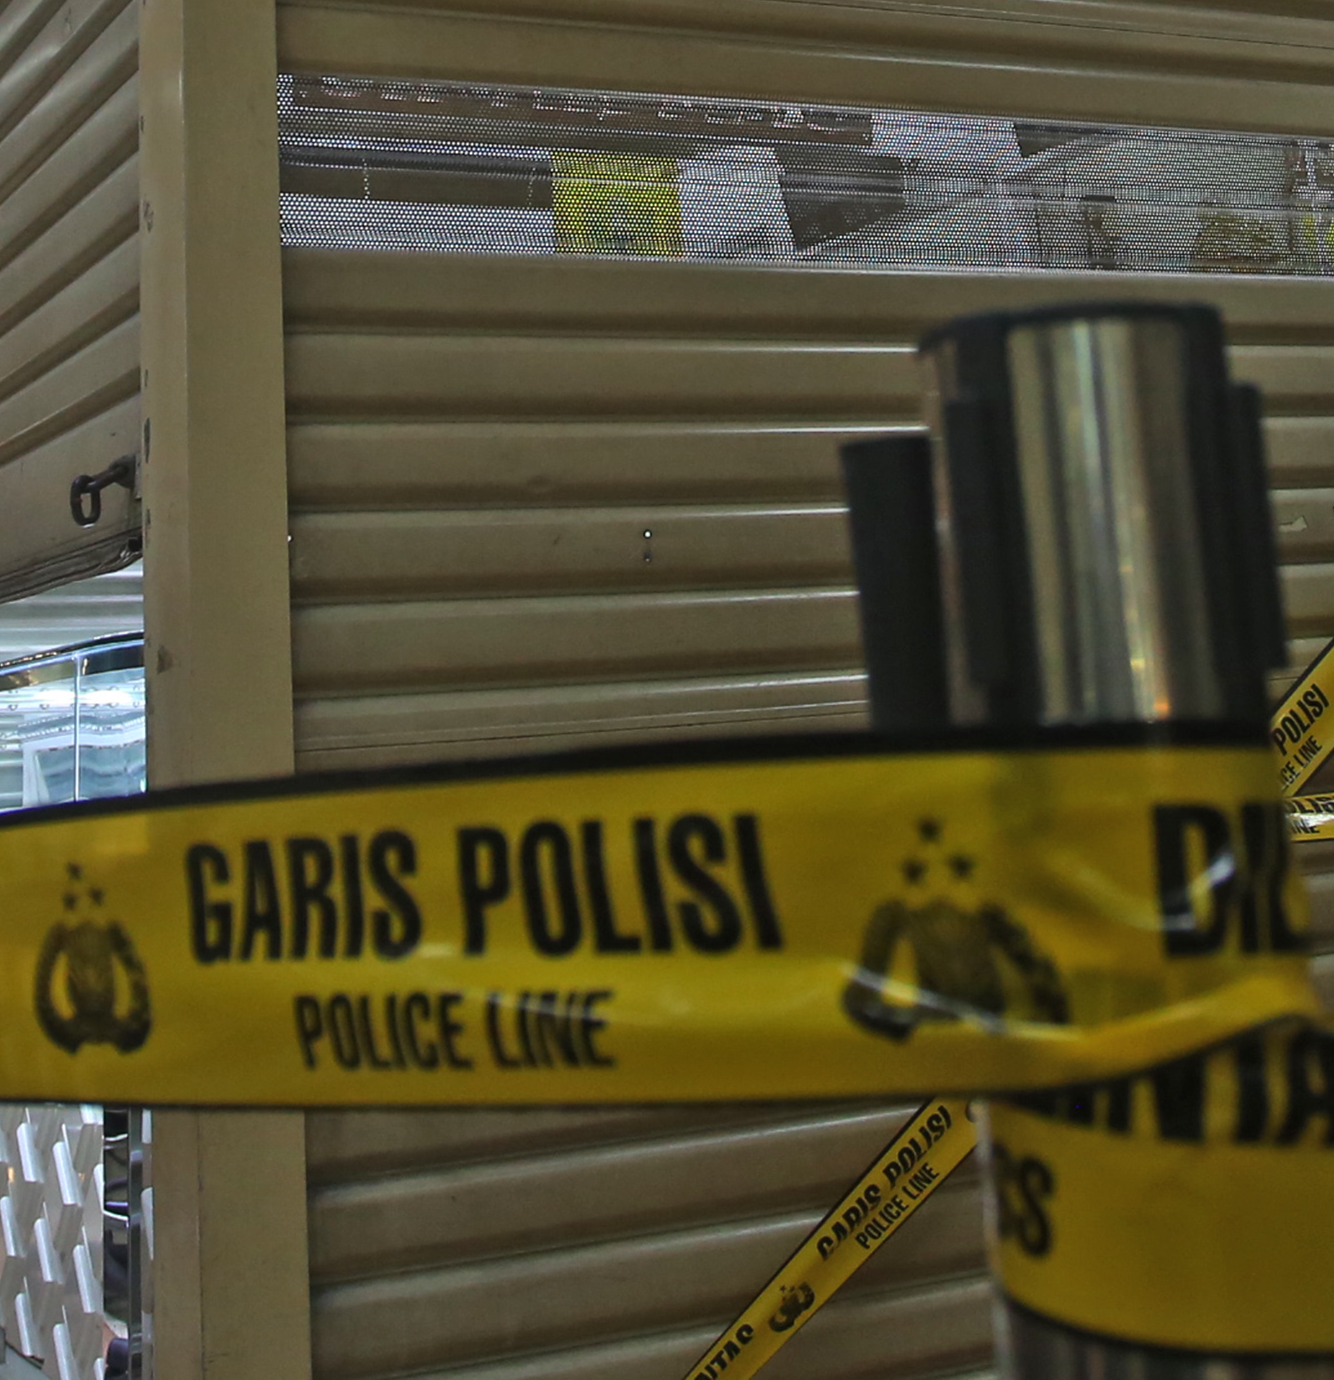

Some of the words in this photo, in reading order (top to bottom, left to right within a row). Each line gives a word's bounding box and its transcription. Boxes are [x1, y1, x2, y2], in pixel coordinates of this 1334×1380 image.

[1271, 684, 1330, 756] POLISI
[1295, 734, 1323, 771] LINE
[183, 828, 423, 966] GARIS
[455, 810, 785, 958] POLISI
[294, 992, 475, 1073] POLICE
[488, 989, 617, 1071] LINE
[854, 1195, 910, 1251] POLICE
[902, 1162, 940, 1202] LINE
